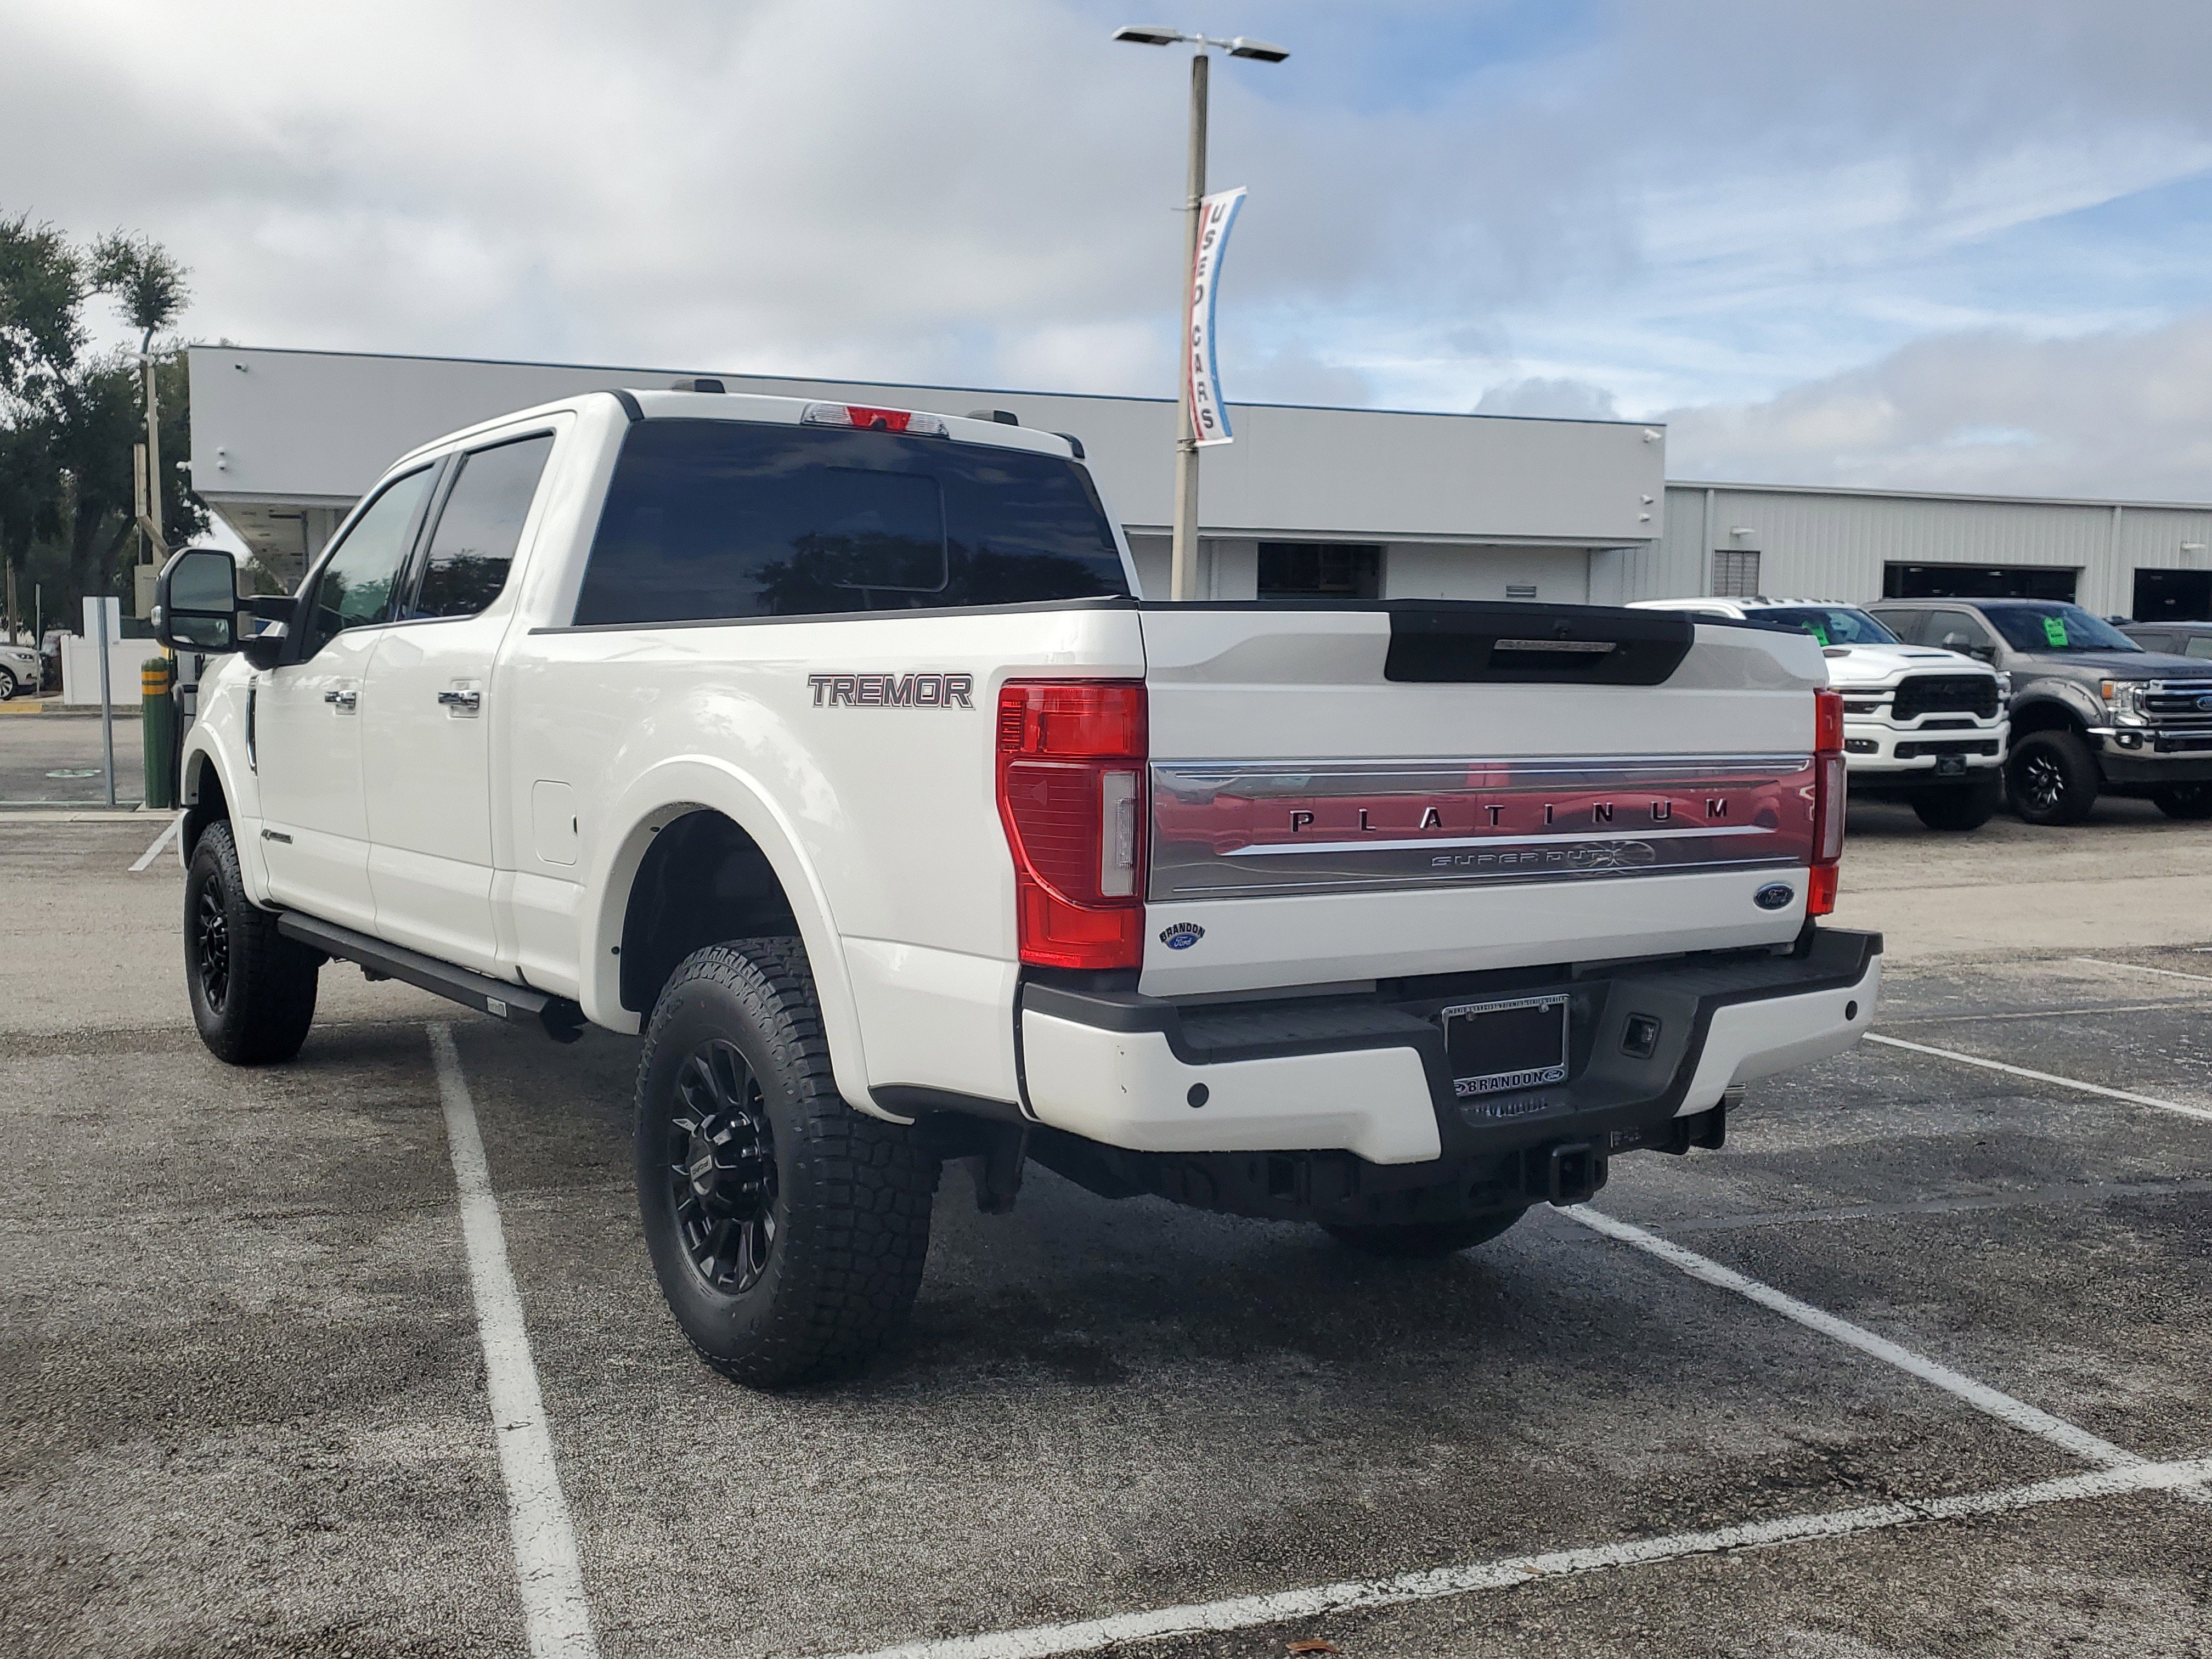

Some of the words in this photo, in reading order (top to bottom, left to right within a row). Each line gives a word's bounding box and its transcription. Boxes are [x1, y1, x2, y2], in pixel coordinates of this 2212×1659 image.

[1194, 204, 1225, 305] USED
[1192, 325, 1214, 428] CARS
[807, 673, 975, 710] TREMOR
[1289, 797, 1728, 833] PLATINUM
[1431, 852, 1538, 867] SUPER
[1159, 923, 1205, 943] BRANDON
[1174, 936, 1192, 947] Ford
[1468, 1071, 1543, 1093] BRANDON
